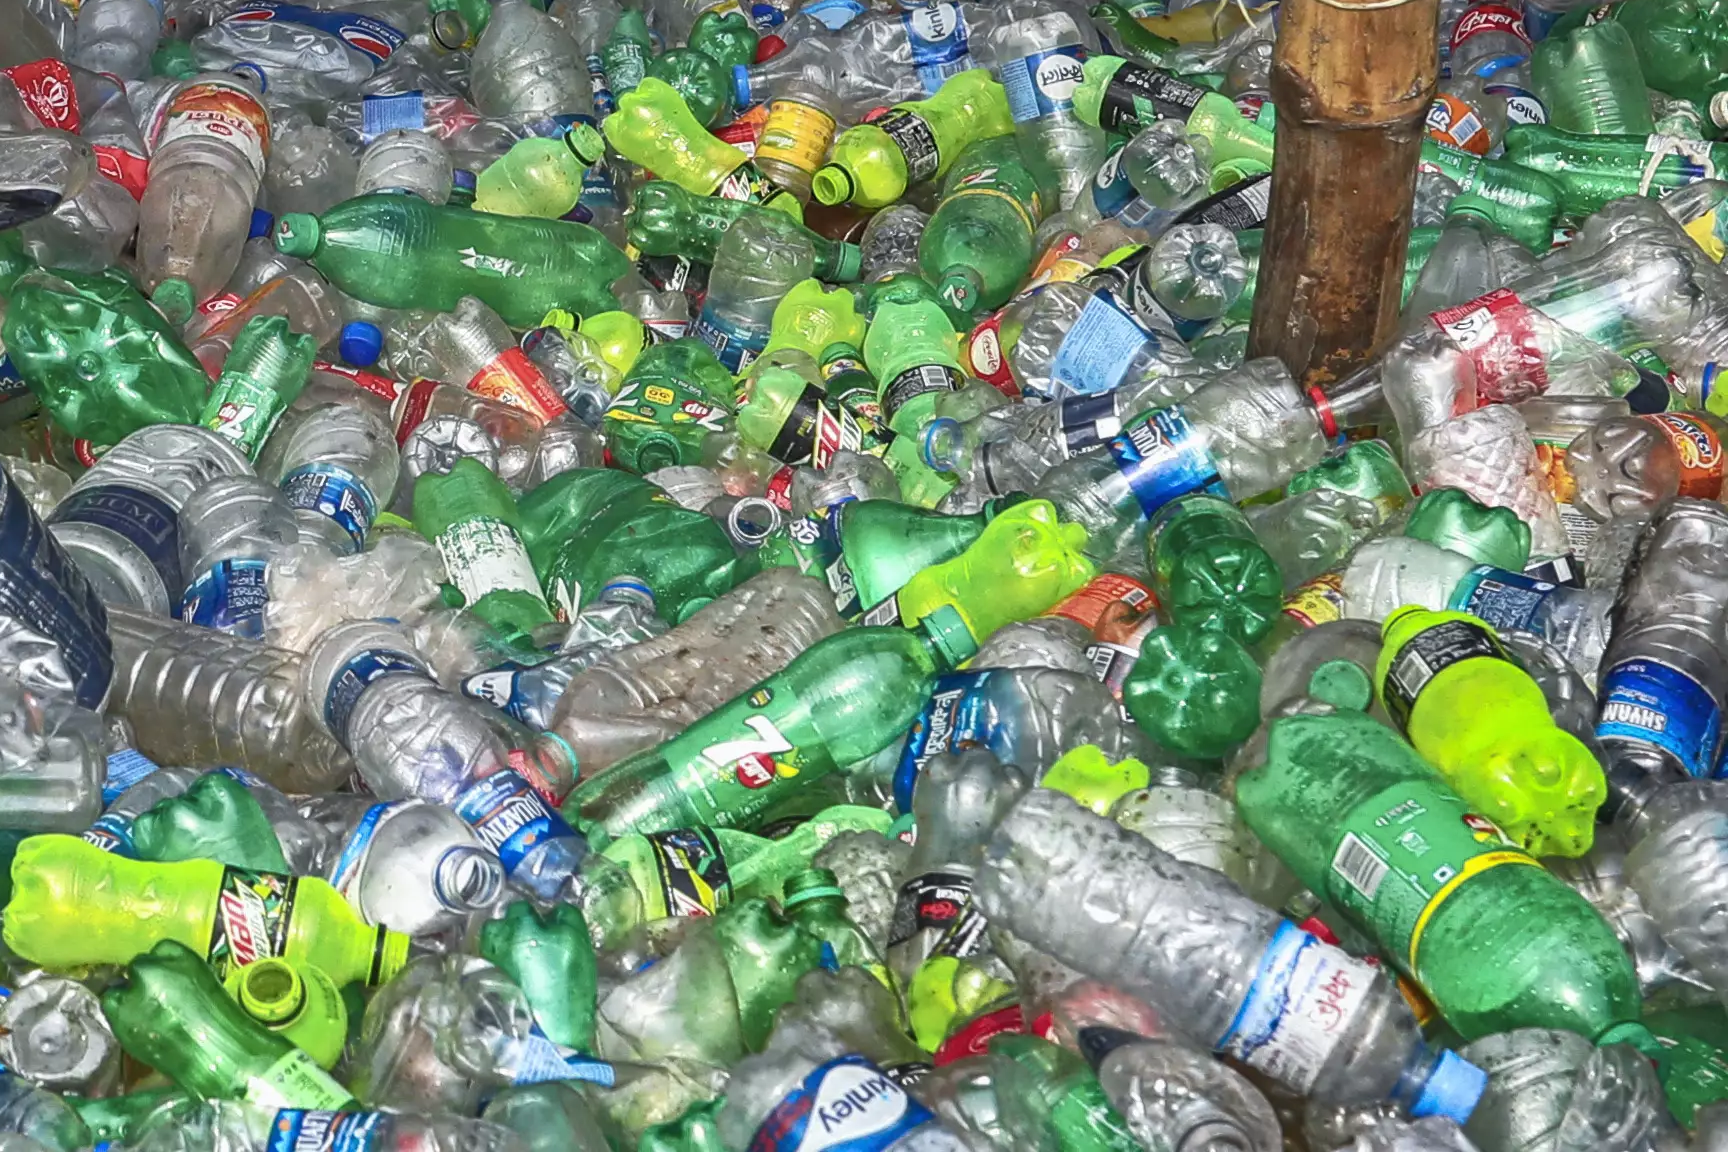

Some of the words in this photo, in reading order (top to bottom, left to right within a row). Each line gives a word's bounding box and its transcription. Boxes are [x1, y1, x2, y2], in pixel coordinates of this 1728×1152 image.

[355, 18, 401, 46] pepsi
[931, 0, 944, 39] kinle
[1603, 702, 1666, 730] SHYAM
[818, 1077, 904, 1132] kinley
